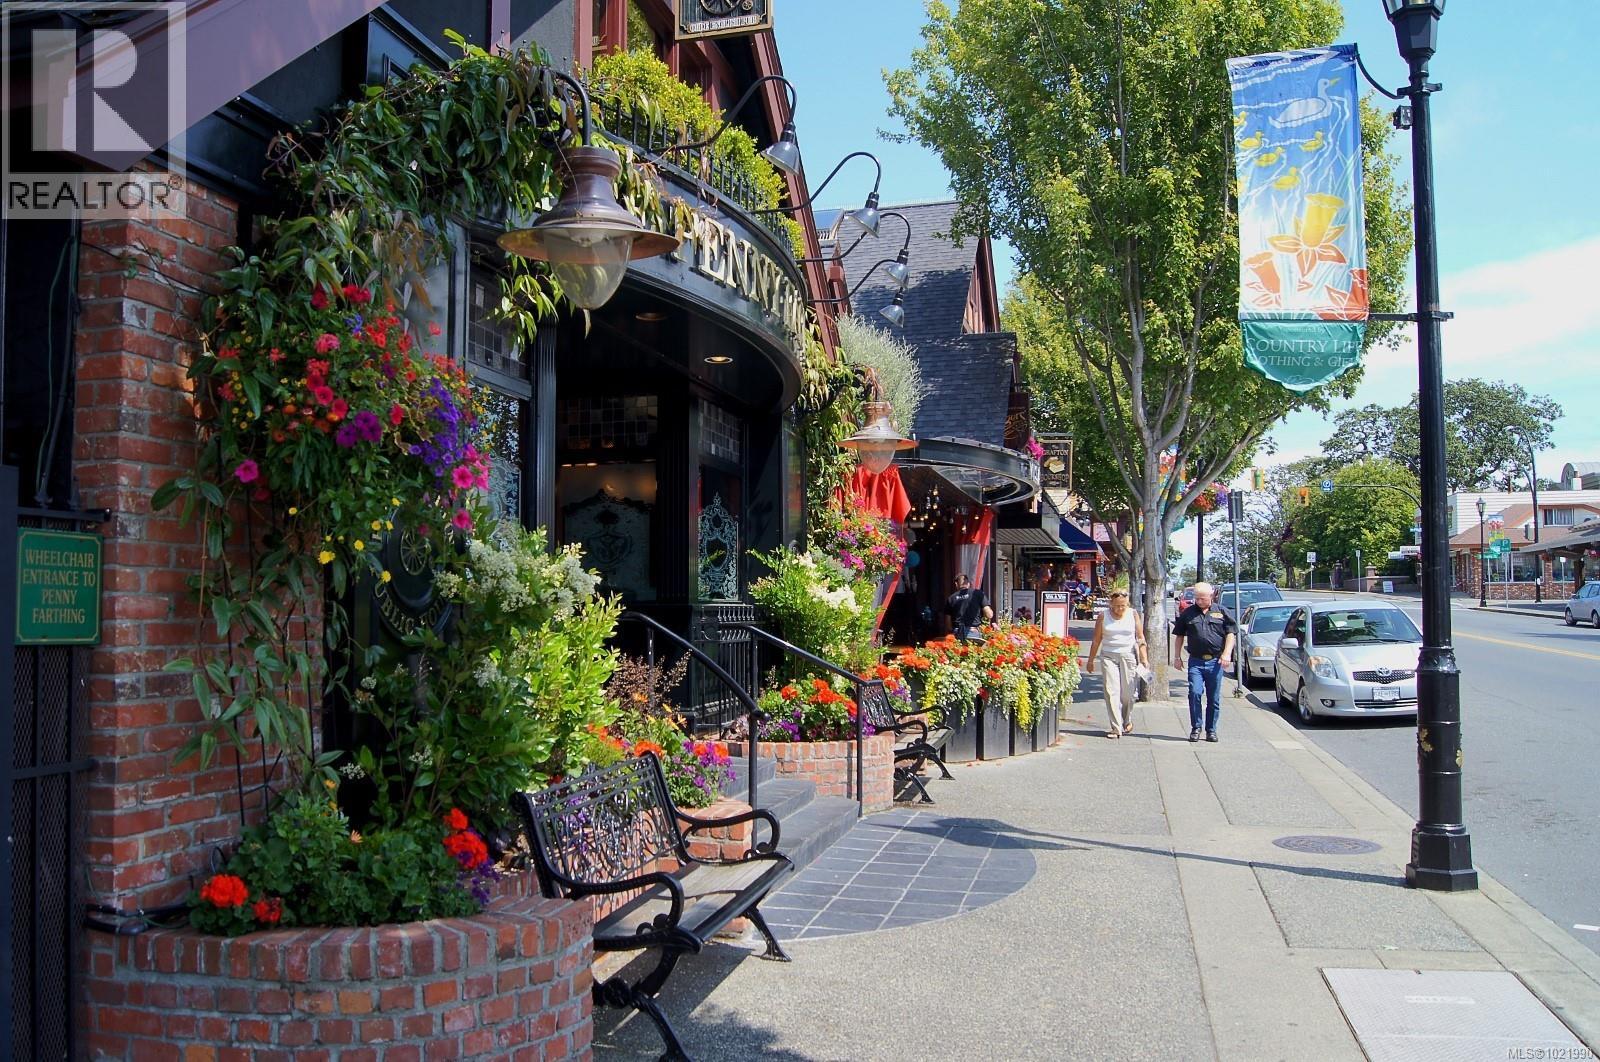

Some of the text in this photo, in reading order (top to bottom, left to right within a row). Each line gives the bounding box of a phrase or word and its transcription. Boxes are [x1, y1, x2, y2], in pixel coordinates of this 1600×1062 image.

[1247, 338, 1328, 353] COUNTRY
[1314, 358, 1325, 367] &
[25, 549, 94, 568] WHEELCHAIR
[23, 568, 95, 587] ENTRANCE TO
[42, 588, 77, 605] PENNY
[32, 607, 85, 625] FARTHING
